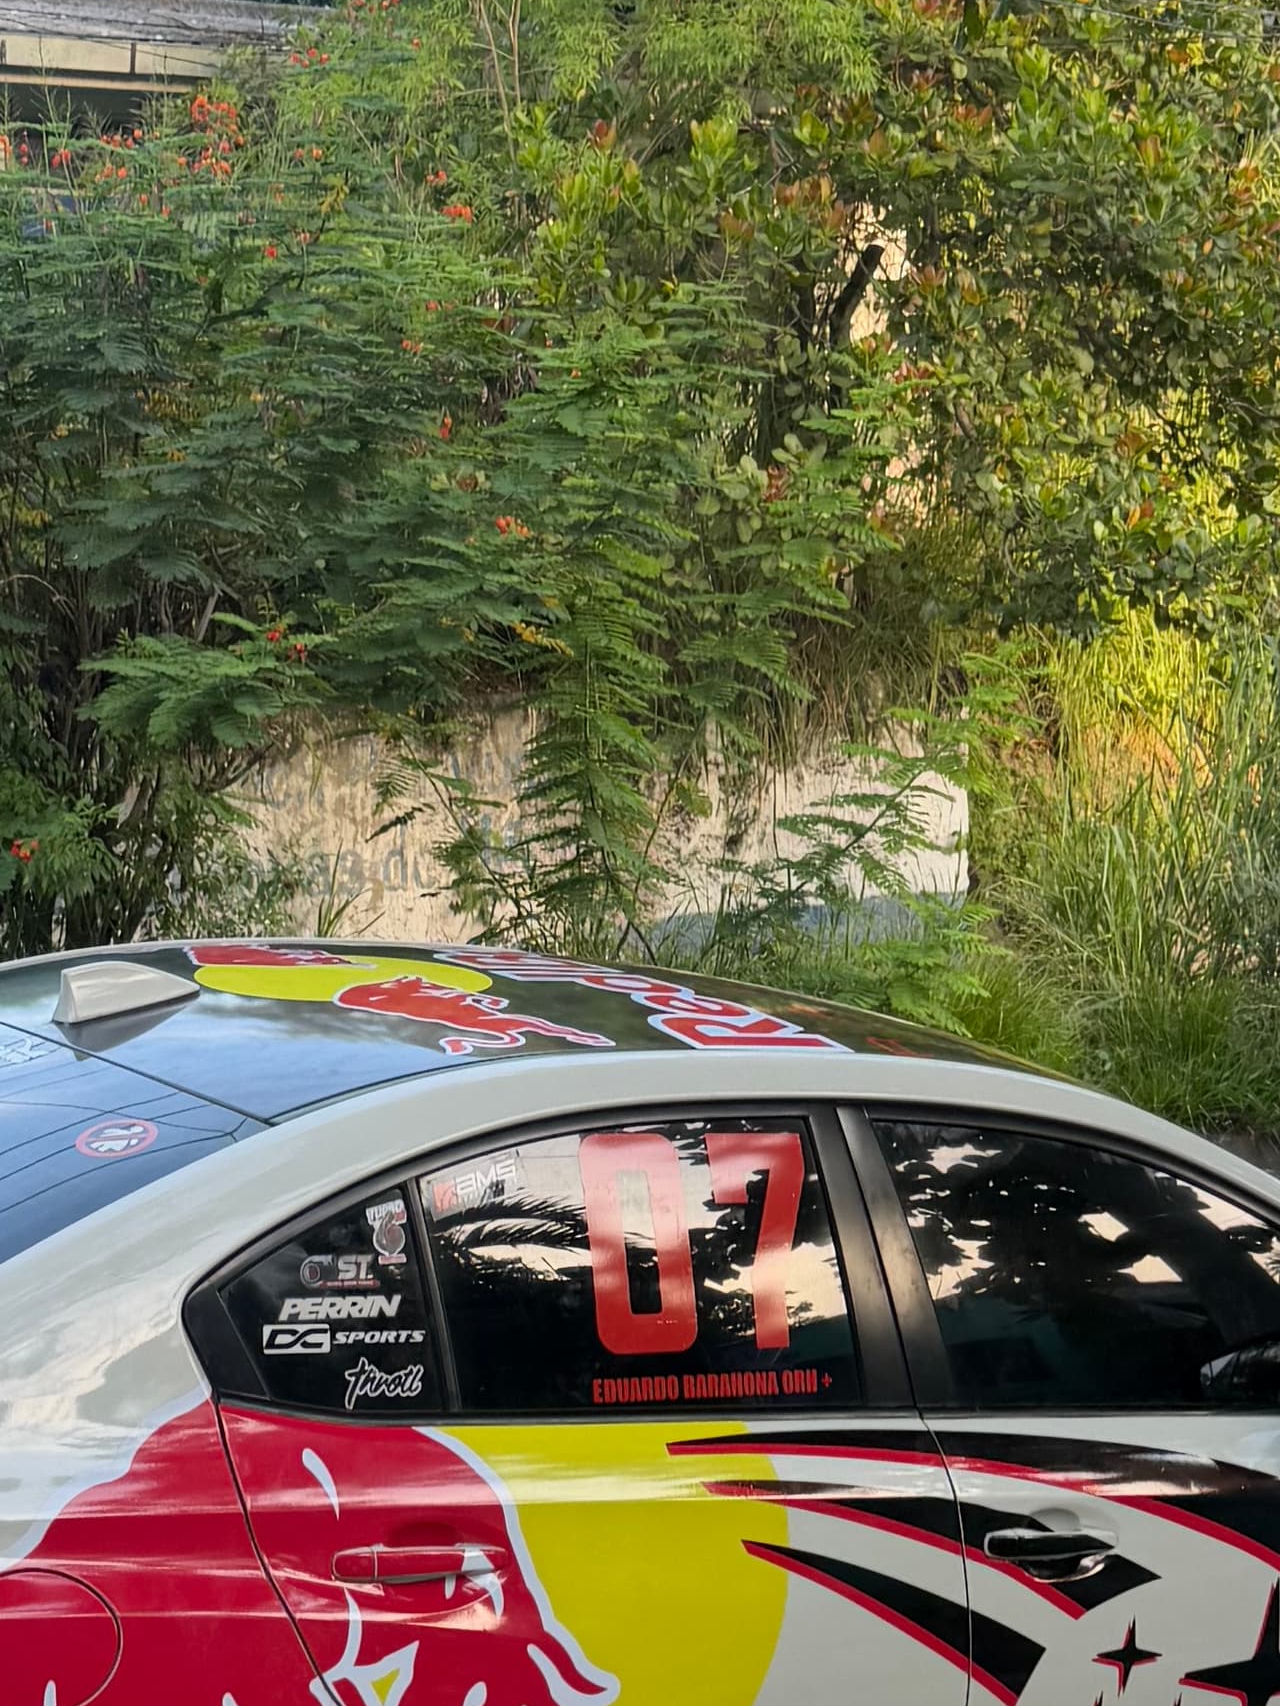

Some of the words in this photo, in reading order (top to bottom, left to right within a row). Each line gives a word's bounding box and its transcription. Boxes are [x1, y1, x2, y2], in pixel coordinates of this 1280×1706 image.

[579, 1132, 805, 1354] 07
[278, 1294, 402, 1322] PERRIN
[332, 1329, 426, 1345] SPORTS
[592, 1374, 680, 1404] EDUARDO
[682, 1370, 780, 1400] BARAHONA
